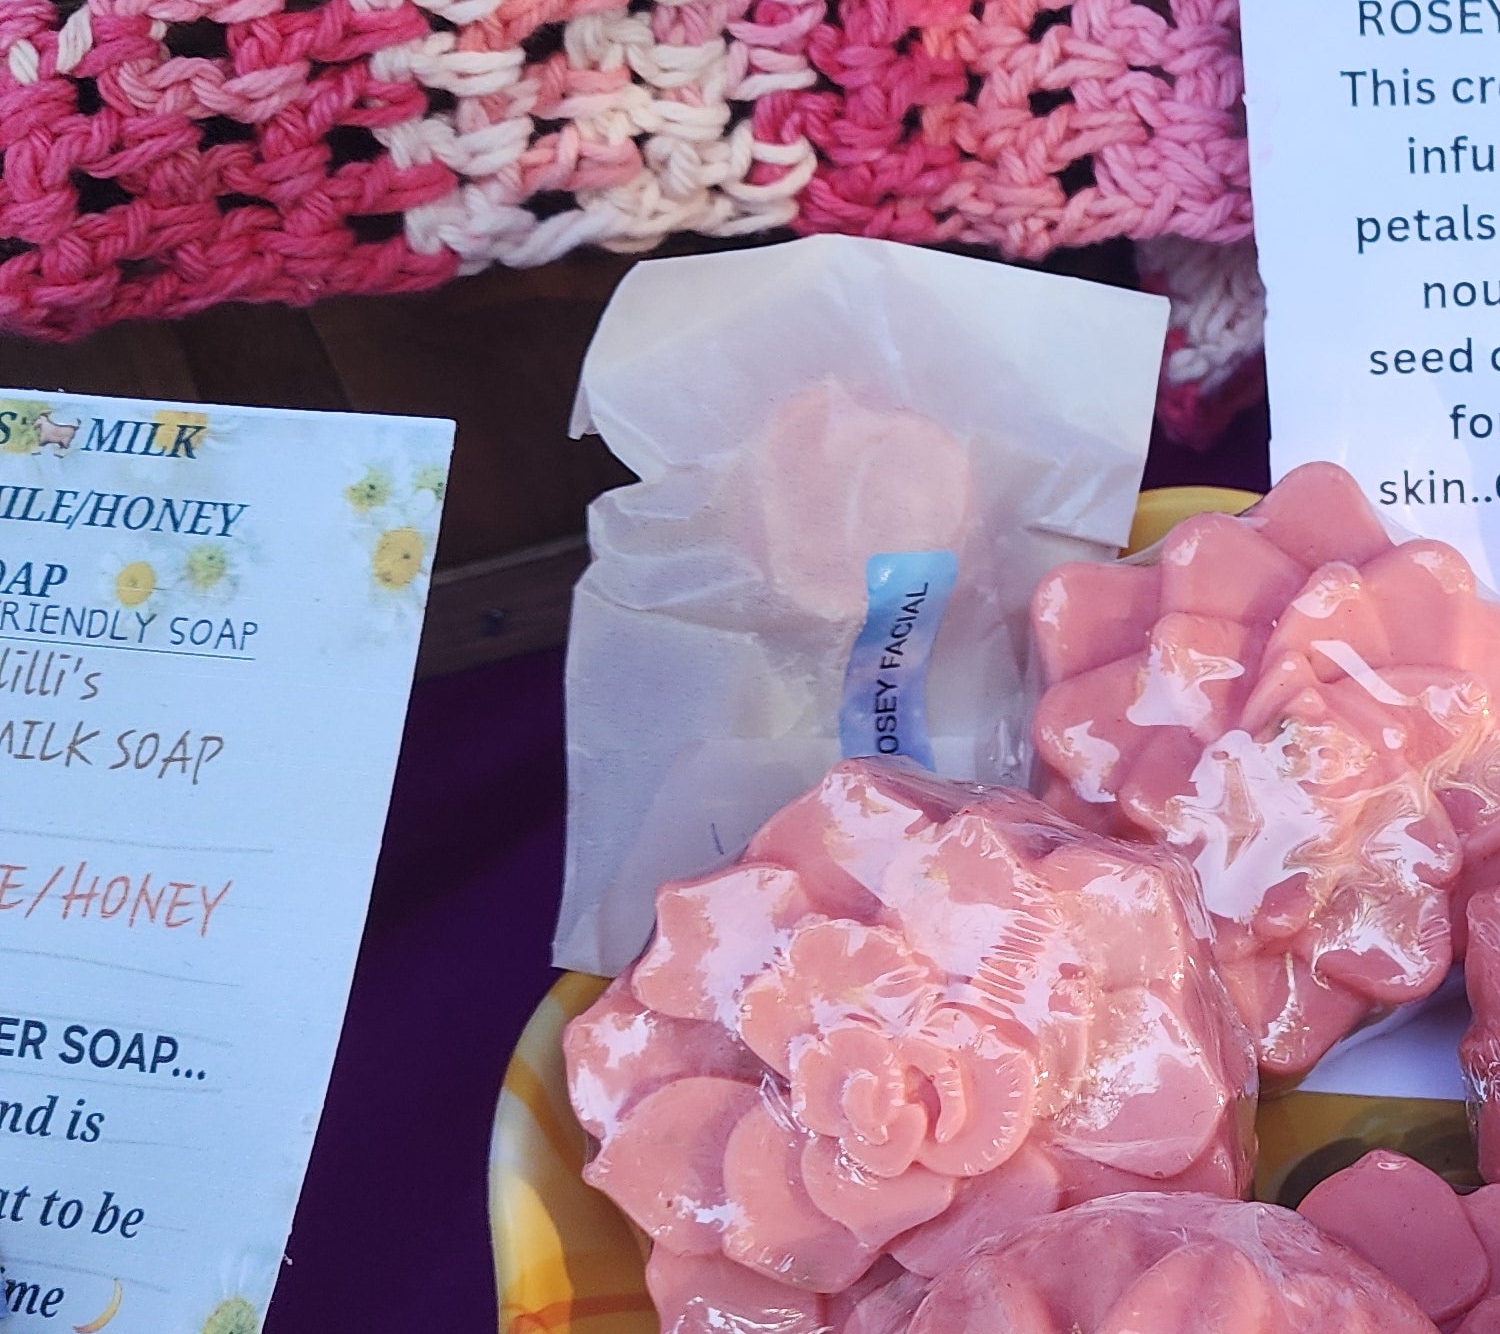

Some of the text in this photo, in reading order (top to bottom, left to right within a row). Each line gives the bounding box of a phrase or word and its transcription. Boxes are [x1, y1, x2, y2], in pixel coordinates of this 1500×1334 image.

[1339, 67, 1437, 108] This
[1355, 203, 1497, 255] petals
[1369, 336, 1474, 376] seed
[81, 417, 207, 460] MILK
[0, 484, 250, 538] ILE/HONEY
[0, 600, 259, 652] RIENDLY SOAP
[875, 581, 929, 755] OSEY FACIAL
[108, 729, 225, 786] SOAP
[58, 1024, 207, 1081] SOAP...
[66, 1098, 106, 1143] is
[39, 1189, 85, 1231] to
[91, 1190, 146, 1240] be
